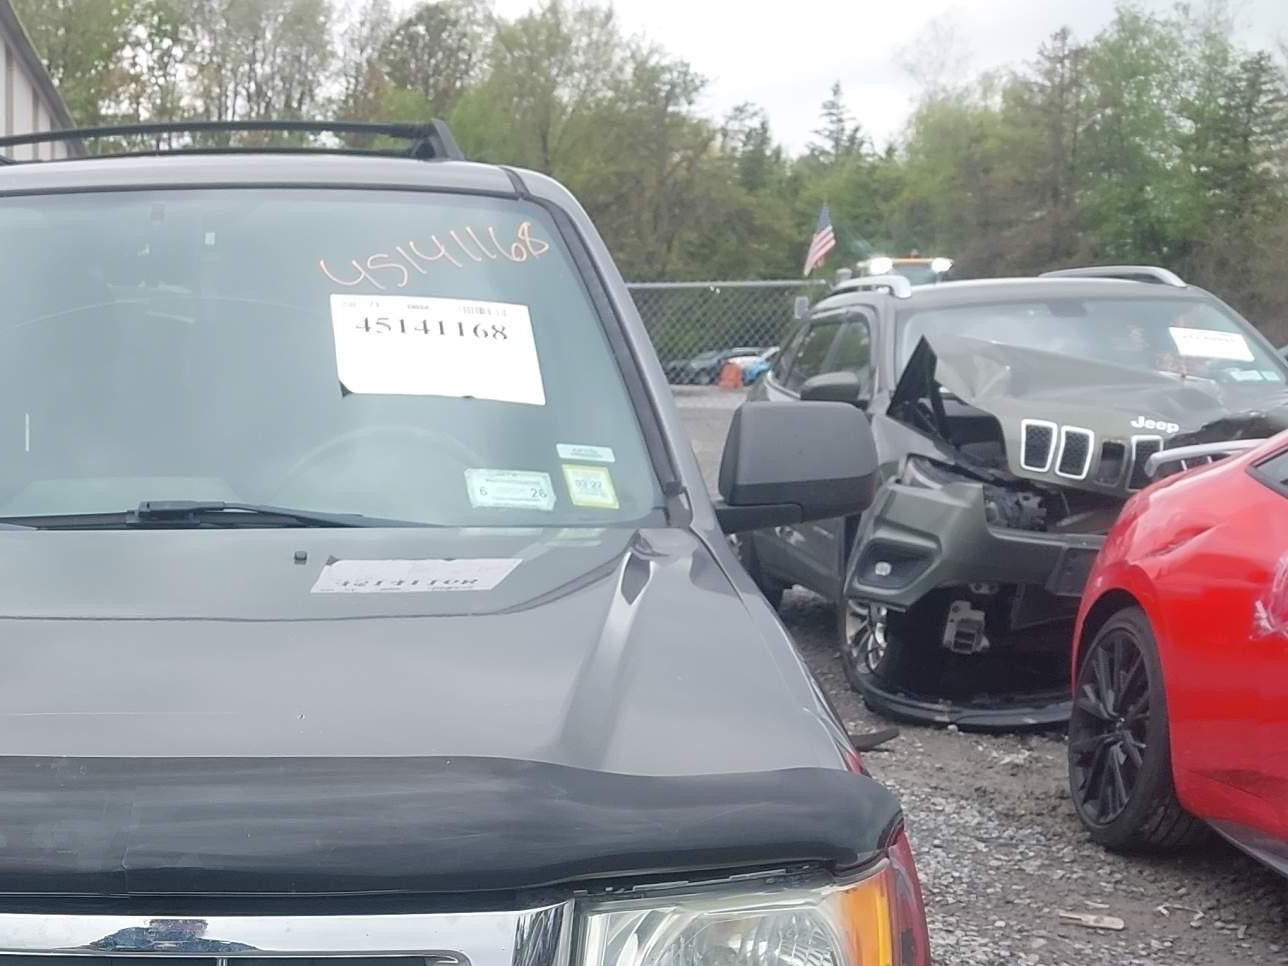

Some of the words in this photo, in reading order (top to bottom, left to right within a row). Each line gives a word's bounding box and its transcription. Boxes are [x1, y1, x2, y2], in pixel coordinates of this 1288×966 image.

[319, 221, 550, 290] 45141168
[355, 316, 509, 340] 45141168
[1130, 415, 1180, 434] Jeep
